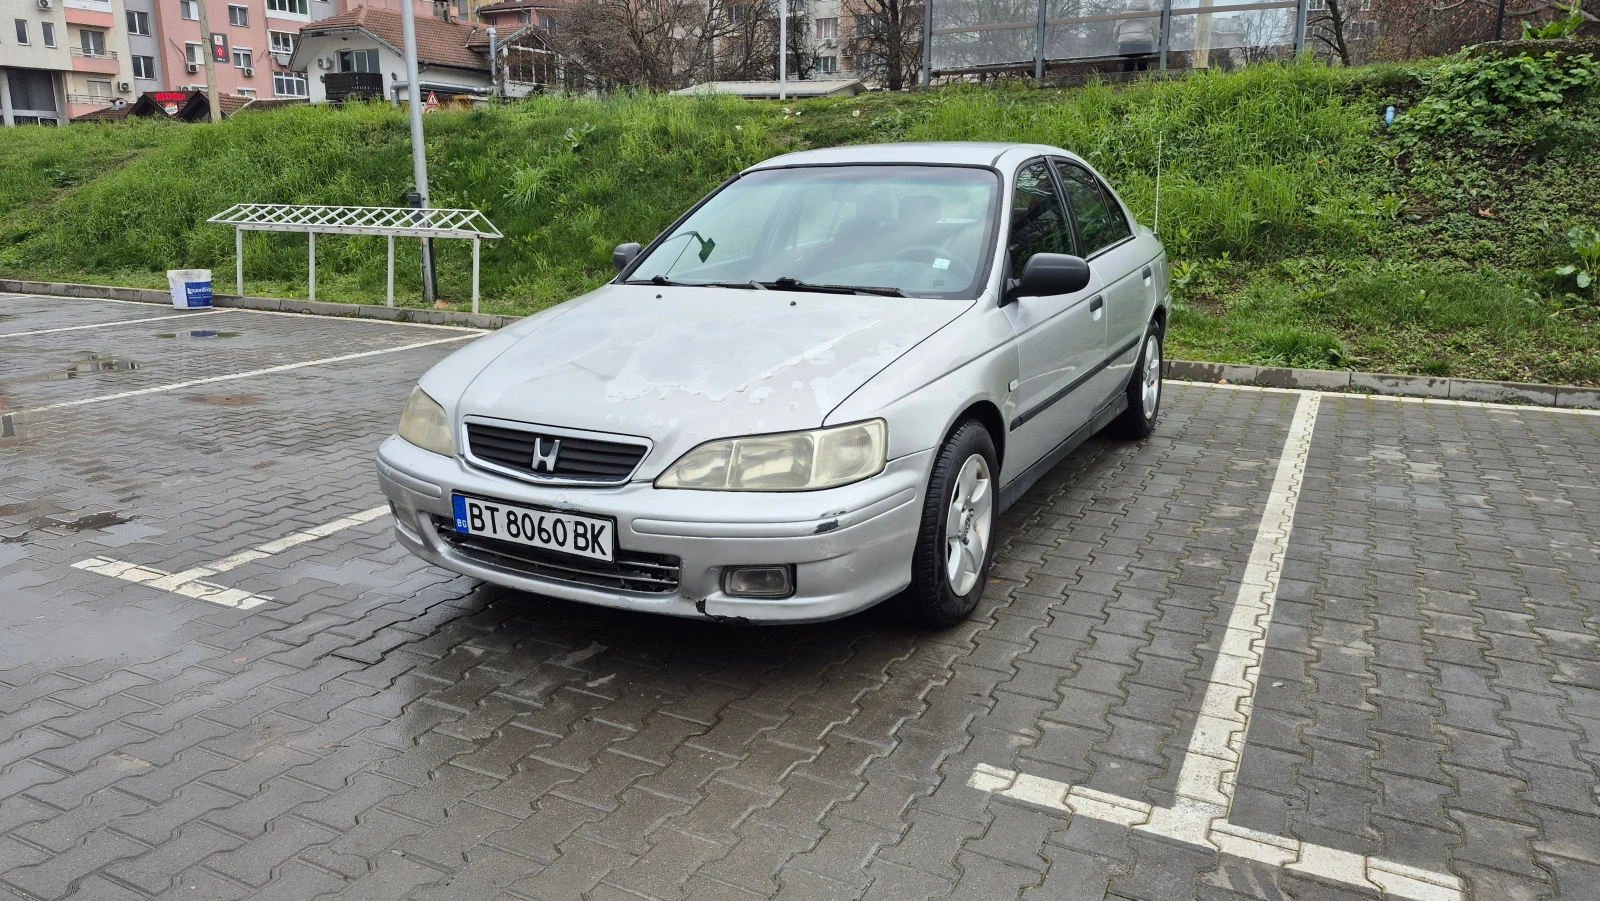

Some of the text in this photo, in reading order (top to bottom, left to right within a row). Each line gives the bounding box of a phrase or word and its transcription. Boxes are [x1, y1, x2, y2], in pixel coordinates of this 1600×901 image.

[456, 518, 467, 528] BG
[468, 502, 607, 556] BT 8060 BK
